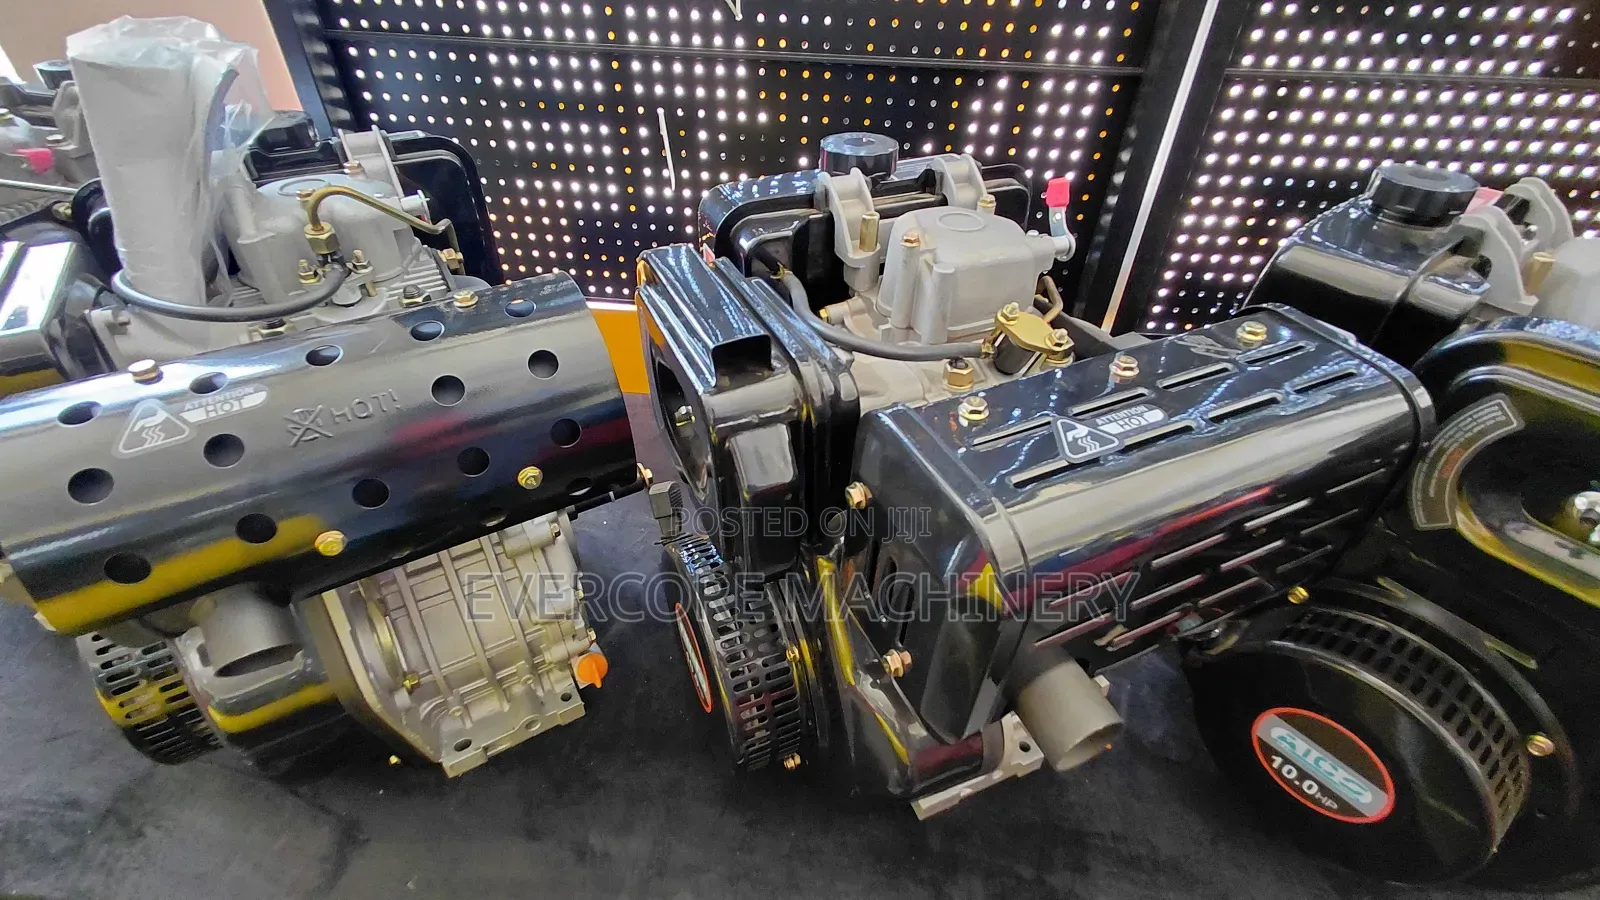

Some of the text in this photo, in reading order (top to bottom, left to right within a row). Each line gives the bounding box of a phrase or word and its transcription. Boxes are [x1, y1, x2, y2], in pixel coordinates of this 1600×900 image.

[183, 388, 256, 412] ATTENTION
[205, 397, 246, 419] HOT
[330, 388, 402, 424] HOT!
[1095, 405, 1149, 425] ATTENTION
[1117, 415, 1150, 430] HOT
